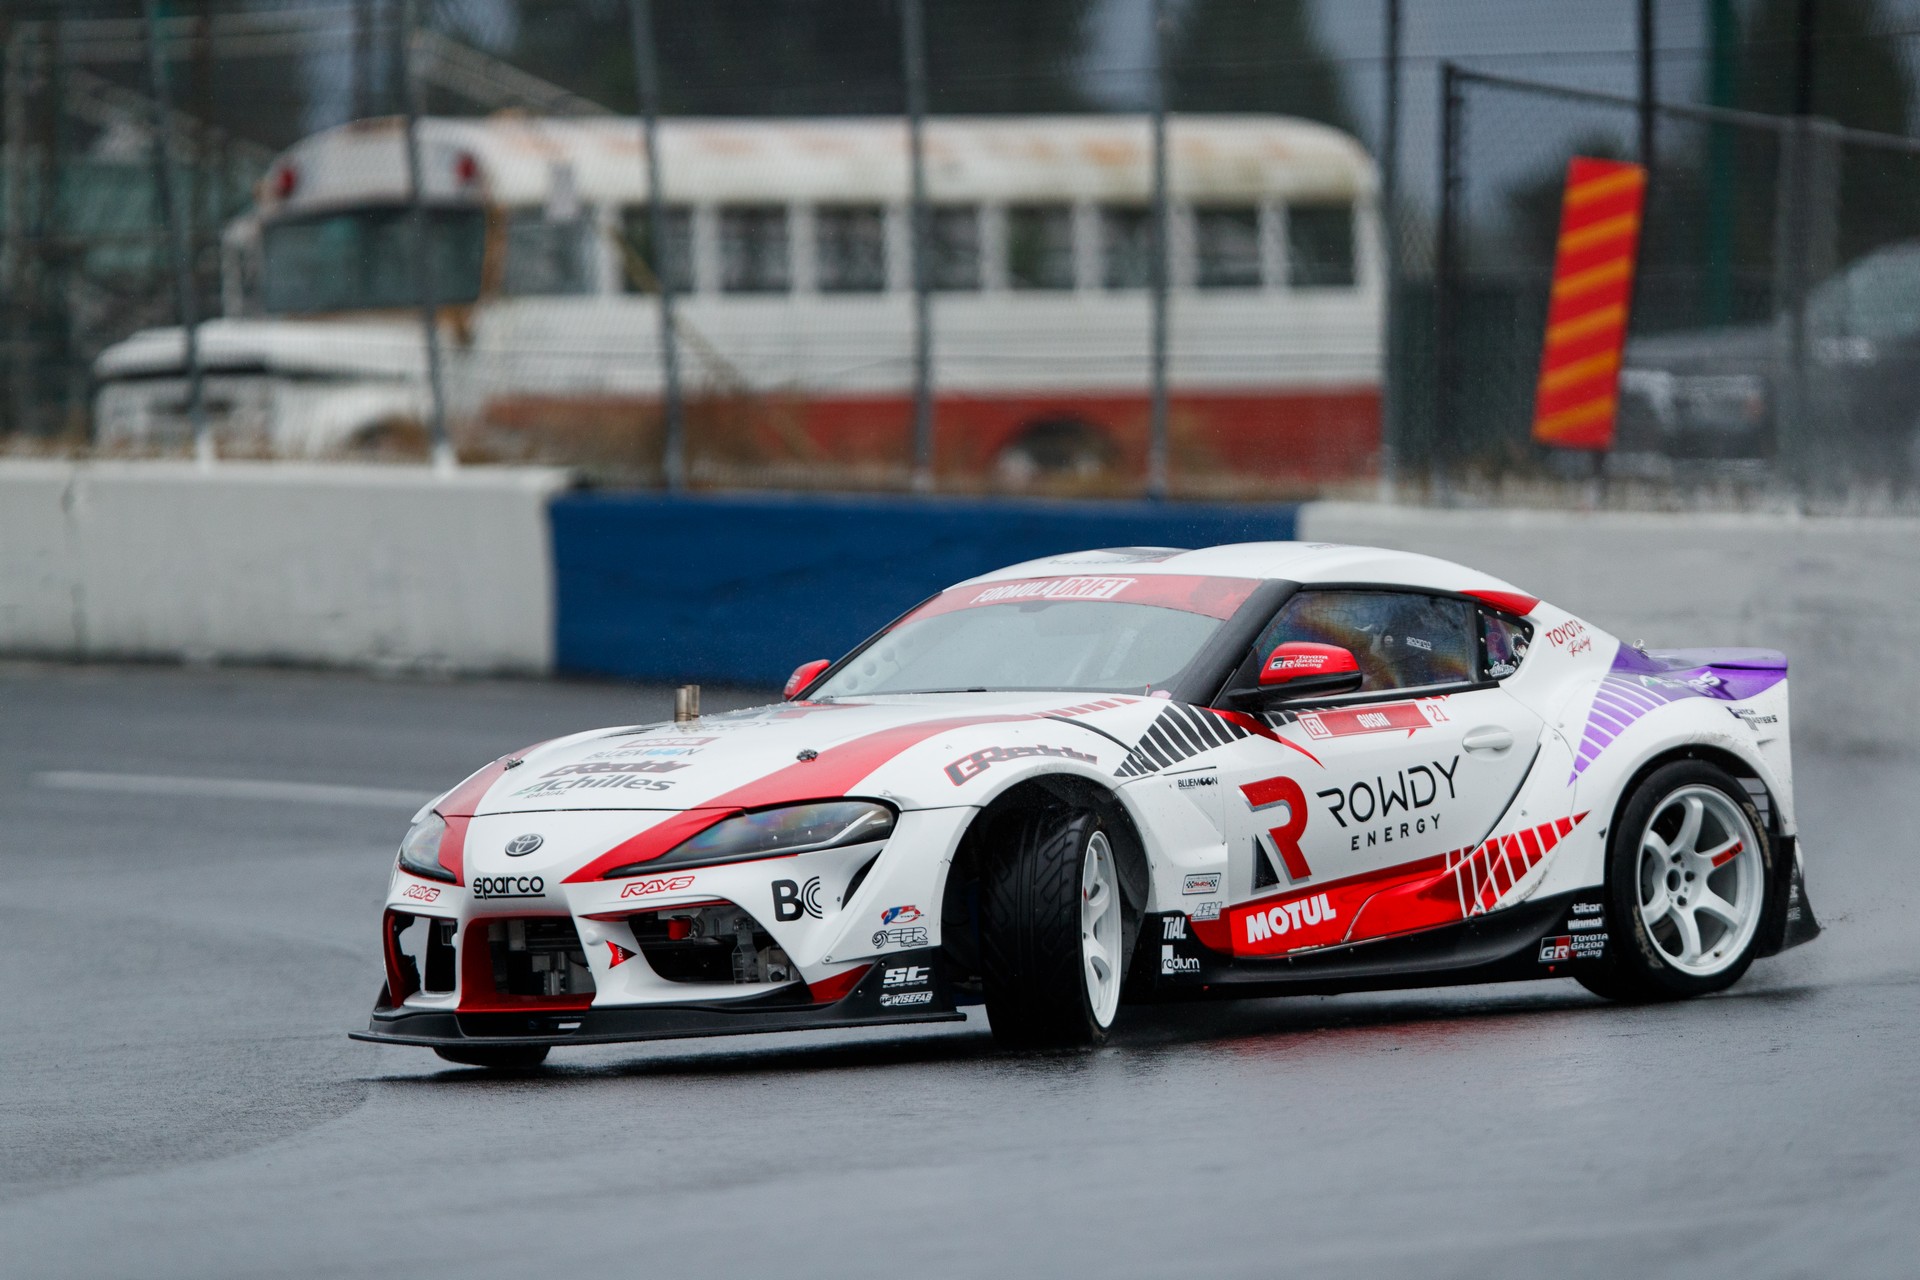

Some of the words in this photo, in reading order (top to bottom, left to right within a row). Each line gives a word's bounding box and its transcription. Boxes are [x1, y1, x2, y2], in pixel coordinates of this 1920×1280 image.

[1545, 619, 1586, 648] TOYOTA
[1270, 660, 1295, 669] GR
[1356, 712, 1391, 729] GUSHI
[1426, 704, 1450, 722] 21
[509, 774, 676, 797] Achilles
[1316, 755, 1460, 828] ROWDY
[1351, 814, 1441, 851] ENERGY
[402, 884, 441, 902] RAYS
[473, 875, 546, 899] sparco
[621, 876, 695, 898] RAYS
[1245, 893, 1337, 944] MOTUL
[886, 927, 928, 943] EFR
[1572, 933, 1609, 942] TOYOTA
[617, 946, 625, 962] TOW
[1540, 945, 1569, 960] GR
[1571, 941, 1604, 950] GAZOO
[1162, 954, 1200, 969] radium
[892, 993, 934, 1004] WISEFAB
